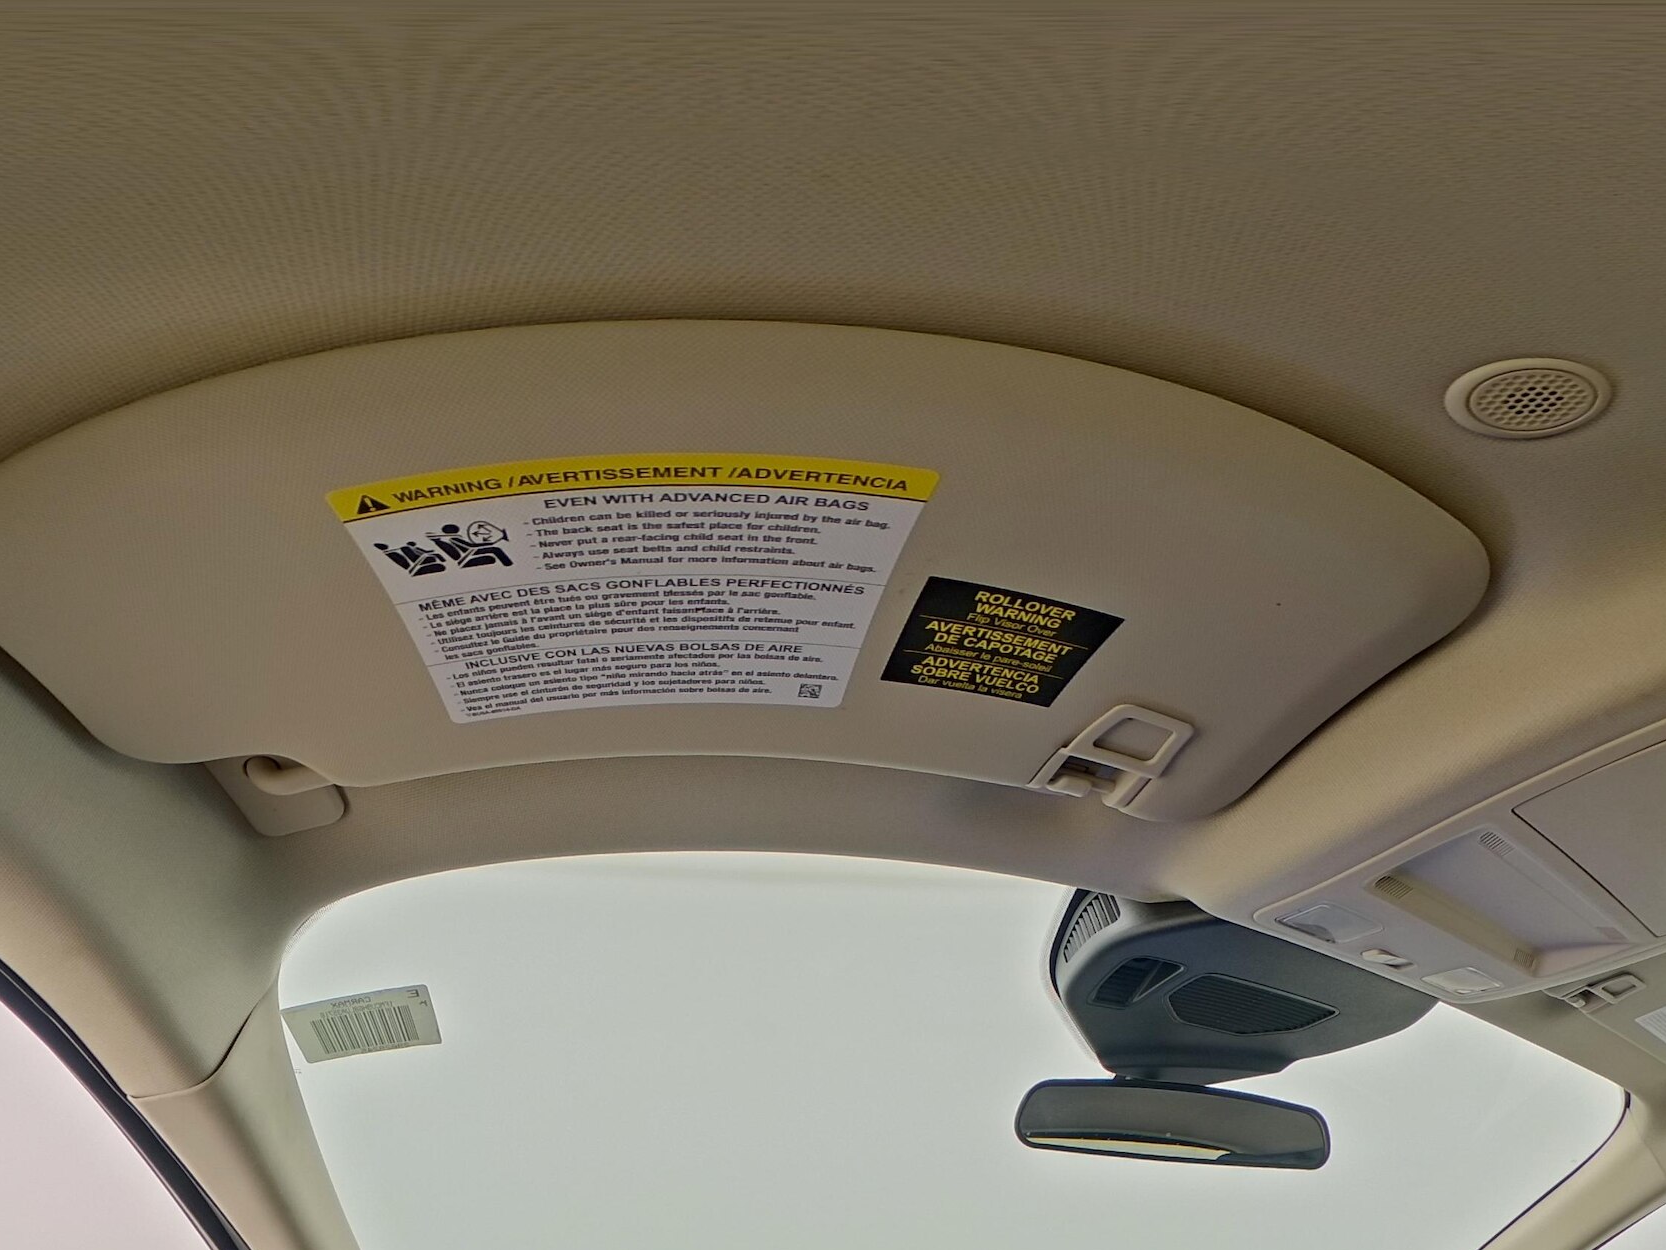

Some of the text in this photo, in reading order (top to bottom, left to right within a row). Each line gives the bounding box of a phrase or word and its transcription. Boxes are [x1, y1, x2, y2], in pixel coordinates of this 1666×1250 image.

[393, 478, 502, 503] WARNING
[544, 493, 870, 511] EVEN WITH ADVANCED AIR BAGS
[533, 515, 585, 525] Children
[590, 513, 612, 521] can
[617, 511, 632, 519] be
[637, 510, 671, 518] killed
[694, 509, 750, 520] seriously
[755, 510, 799, 521] injured
[804, 513, 818, 524] by
[822, 514, 842, 524] the
[845, 517, 862, 526] air
[537, 528, 559, 537] The
[563, 524, 593, 534] back
[597, 523, 623, 532] seat
[628, 522, 638, 530] is
[643, 521, 662, 530] the
[667, 521, 705, 529] safest
[710, 521, 743, 531] place
[748, 522, 764, 530] for
[539, 539, 574, 548] Never
[578, 536, 598, 546] put
[613, 533, 680, 542] rear-facing
[684, 532, 714, 540] child
[718, 533, 744, 541] seat
[748, 533, 758, 541] in
[764, 534, 782, 542] the
[543, 549, 584, 559] Always
[614, 545, 638, 554] seat
[644, 544, 672, 552] belts
[702, 544, 731, 552] child
[545, 561, 566, 570] See
[570, 558, 616, 568] Owner's
[622, 555, 664, 565] Manual
[668, 555, 684, 563] for
[722, 555, 788, 565] information
[794, 558, 824, 567] about
[829, 561, 844, 569] air
[420, 577, 865, 612] MÊME AVEC DES SACS GONFLABLES PERFECTIONNÉS
[974, 591, 1076, 620] ROLLOVER
[966, 612, 1058, 637] Flip Visor Over
[976, 602, 1062, 628] WARNING
[925, 621, 1073, 655] AVERTISSEMENT
[934, 632, 1059, 663] DE CAPOTAGE
[466, 642, 804, 669] INCLUSIVE CON LAS NUEVAS BOLSAS DE AIRE
[925, 643, 979, 657] Abaisser
[992, 655, 1053, 673] pare-soleil
[910, 664, 1040, 694] SOBRE VUELCO
[921, 656, 1039, 684] ADVERTENCIA
[917, 675, 1023, 699] Dar vuelta la visera
